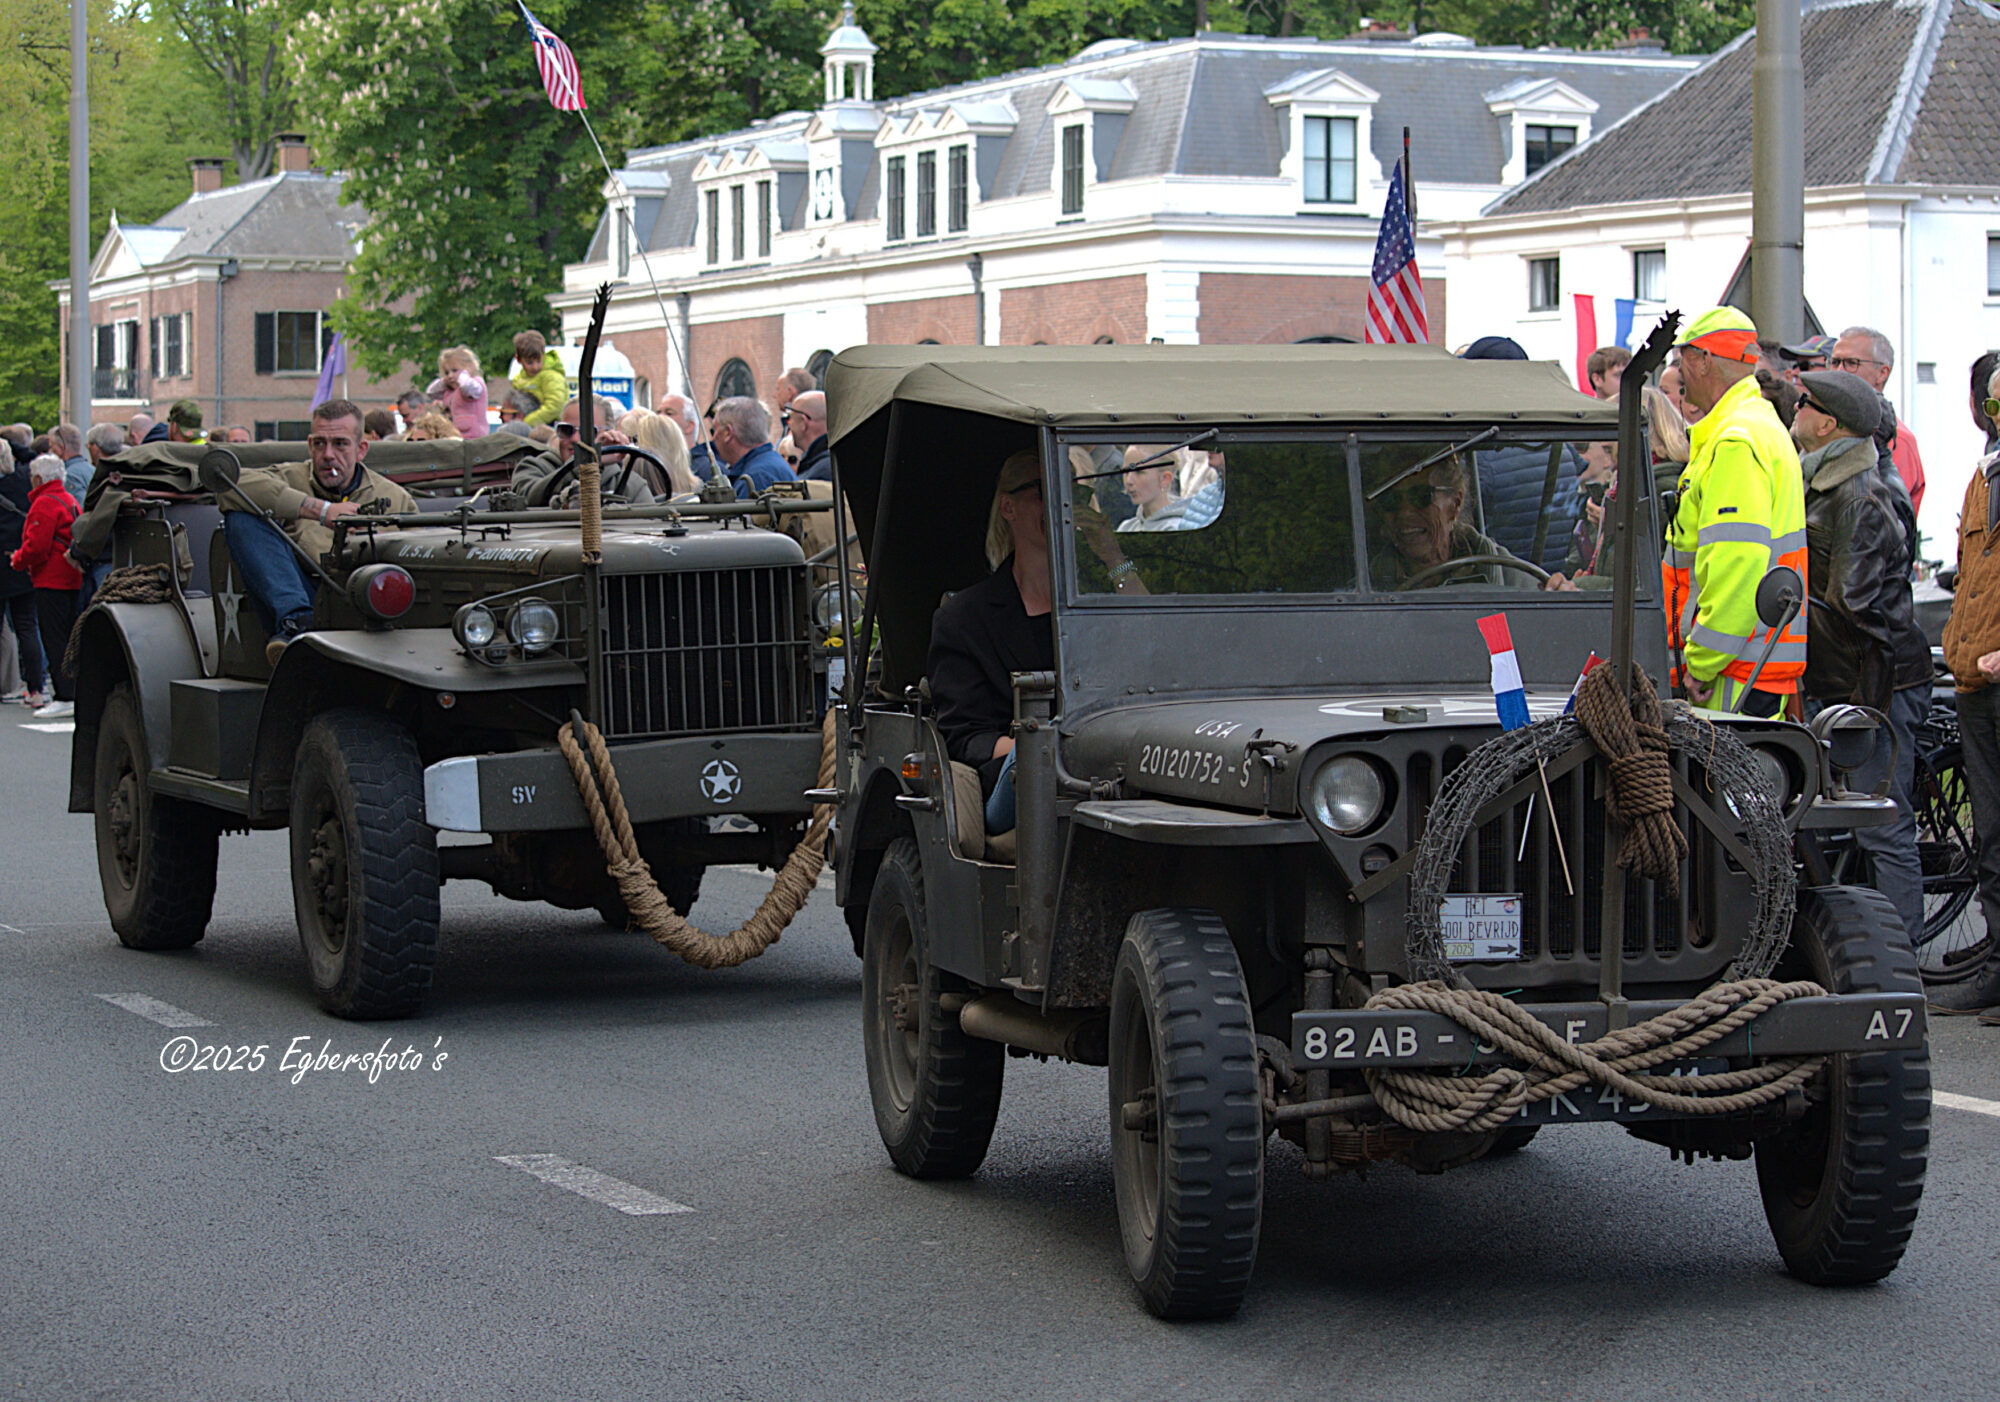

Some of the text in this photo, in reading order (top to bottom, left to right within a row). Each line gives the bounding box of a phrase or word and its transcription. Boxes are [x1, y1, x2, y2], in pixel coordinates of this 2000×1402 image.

[1194, 719, 1242, 739] USA
[512, 785, 536, 804] SV
[1469, 920, 1519, 941] BEVRIJD
[1864, 1008, 1913, 1040] A7
